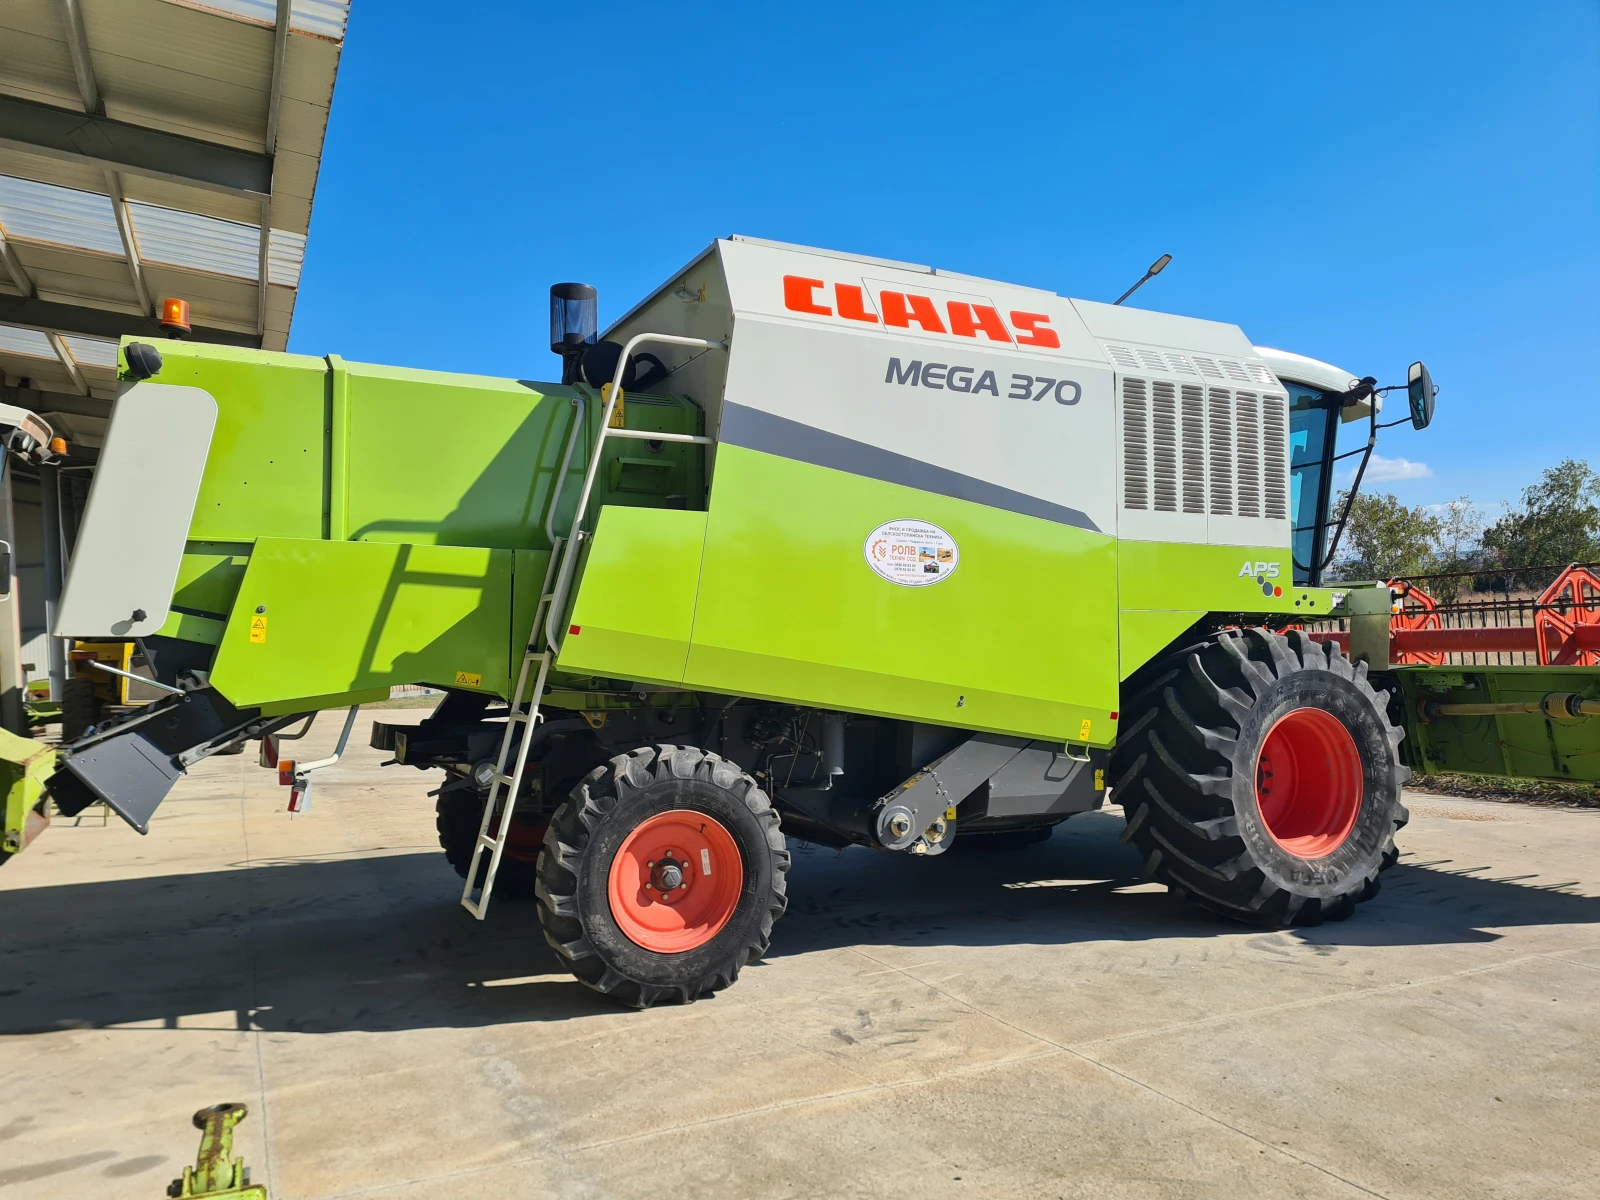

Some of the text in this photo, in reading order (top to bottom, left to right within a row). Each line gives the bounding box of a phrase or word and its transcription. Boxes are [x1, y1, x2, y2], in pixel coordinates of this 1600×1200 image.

[783, 274, 1061, 349] CLAAS
[885, 357, 1082, 406] MEGA 370
[891, 544, 917, 556] РОЛВ
[1238, 561, 1281, 578] APS
[1276, 685, 1284, 696] R
